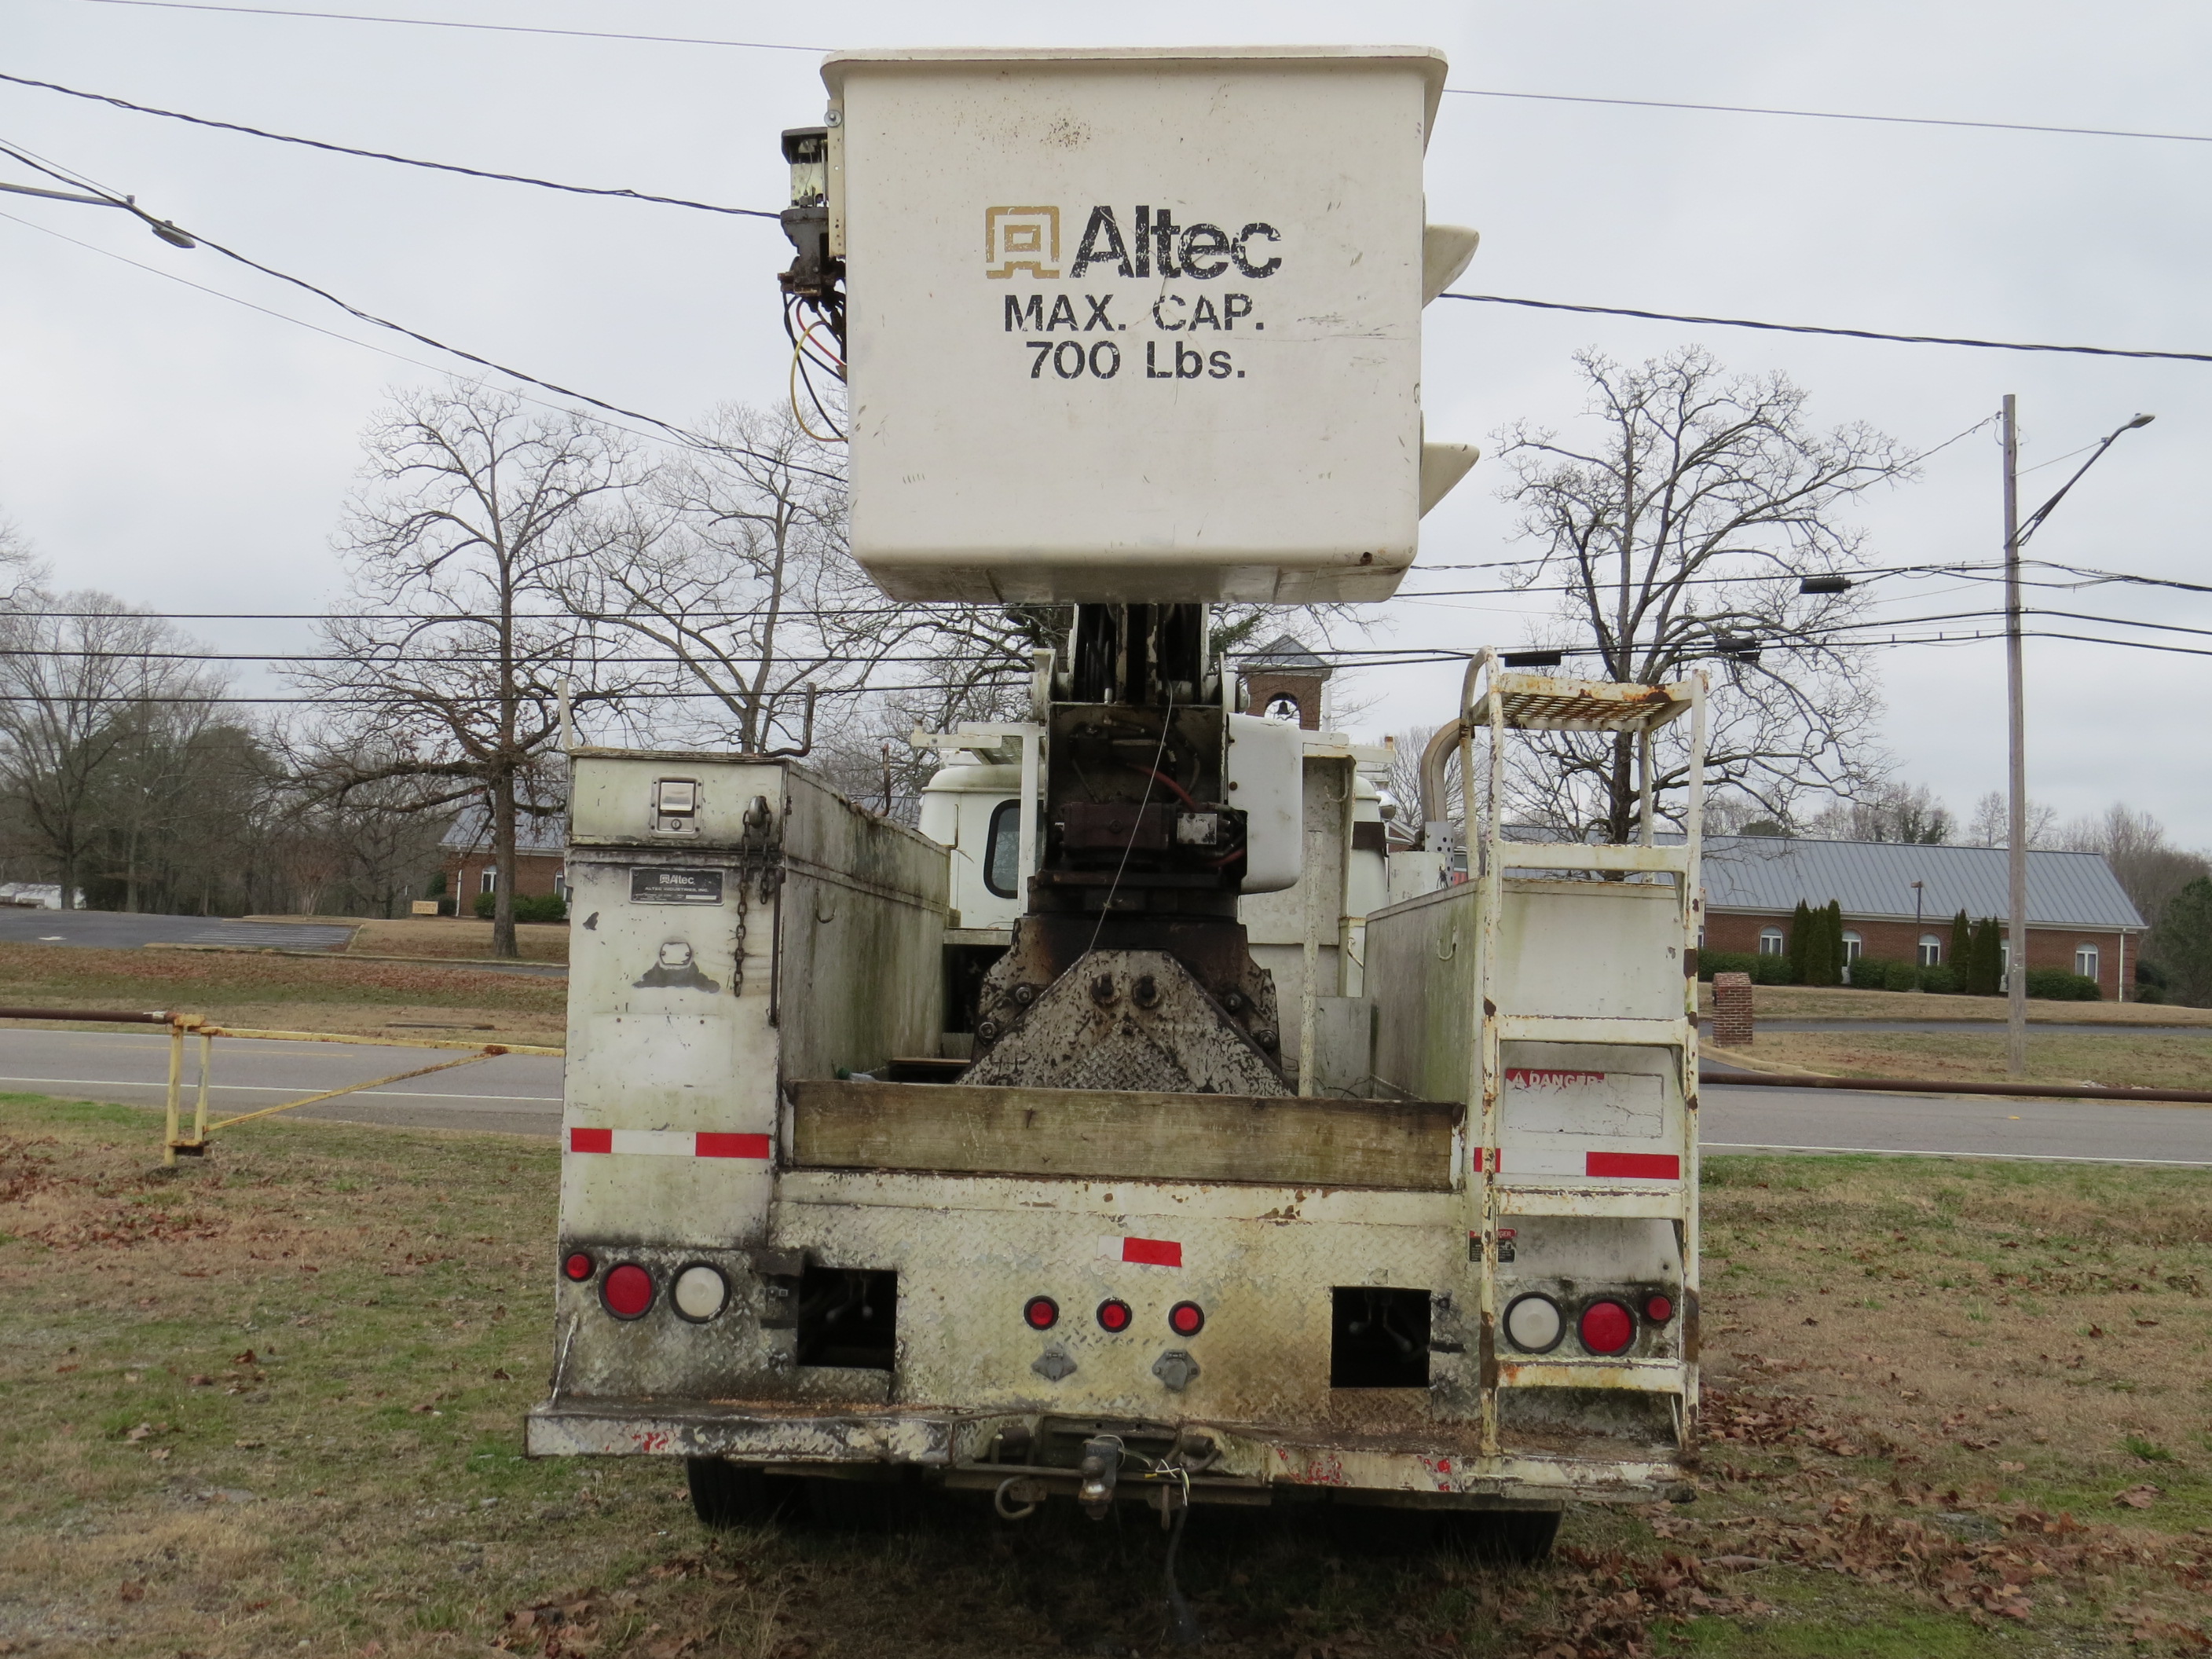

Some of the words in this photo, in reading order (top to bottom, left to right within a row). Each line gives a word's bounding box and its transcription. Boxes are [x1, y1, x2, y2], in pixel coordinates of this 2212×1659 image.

[1069, 205, 1282, 280] Altec
[1005, 295, 1126, 331] MAX.
[1152, 294, 1265, 331] CAP.
[1026, 340, 1121, 379] 700
[1147, 340, 1246, 379] Lbs.
[669, 874, 694, 884] Altec
